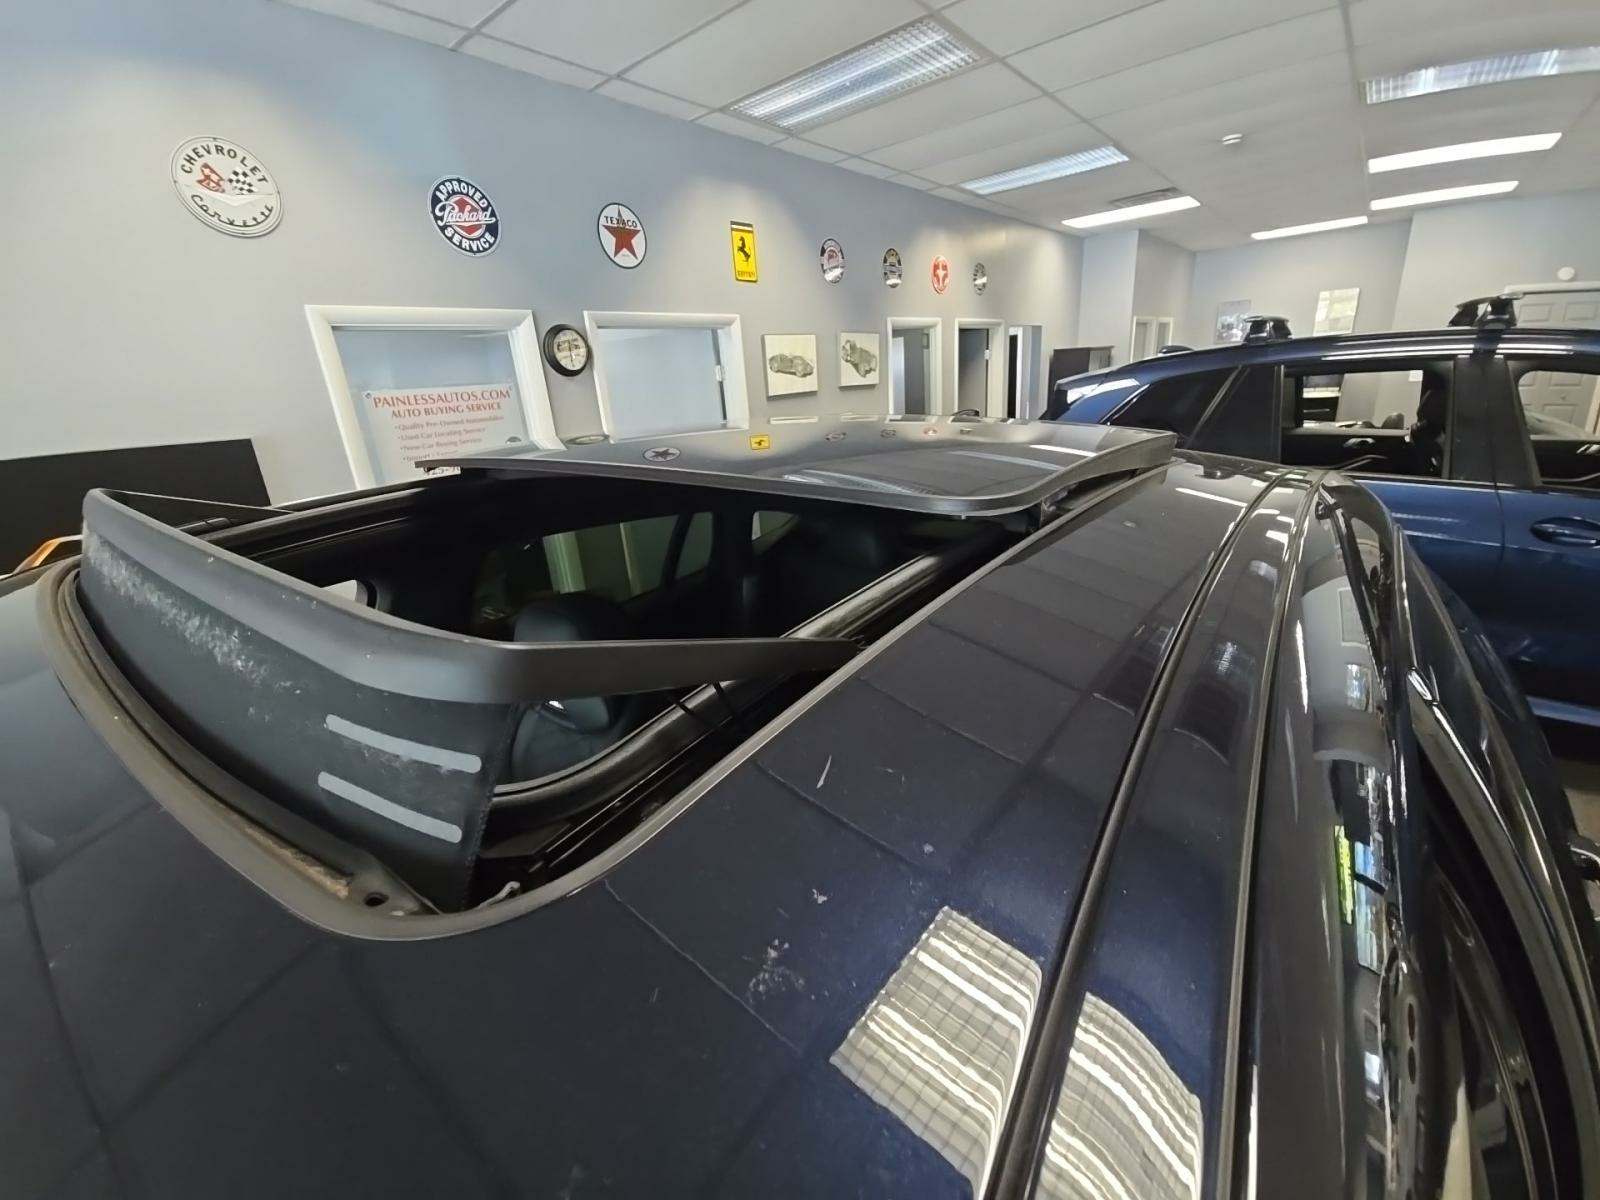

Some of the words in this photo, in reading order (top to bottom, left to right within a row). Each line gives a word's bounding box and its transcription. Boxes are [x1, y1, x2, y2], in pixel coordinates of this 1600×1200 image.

[181, 144, 268, 183] CHEVROLET
[436, 181, 488, 207] APPROVED
[435, 201, 496, 226] Packard
[604, 216, 638, 228] TEXACO
[445, 227, 495, 251] SERVICE
[373, 389, 511, 409] PAINLESSAUTOS.COM
[391, 408, 421, 418] AUTO
[425, 404, 464, 416] BUYING
[466, 402, 502, 413] SERVICE
